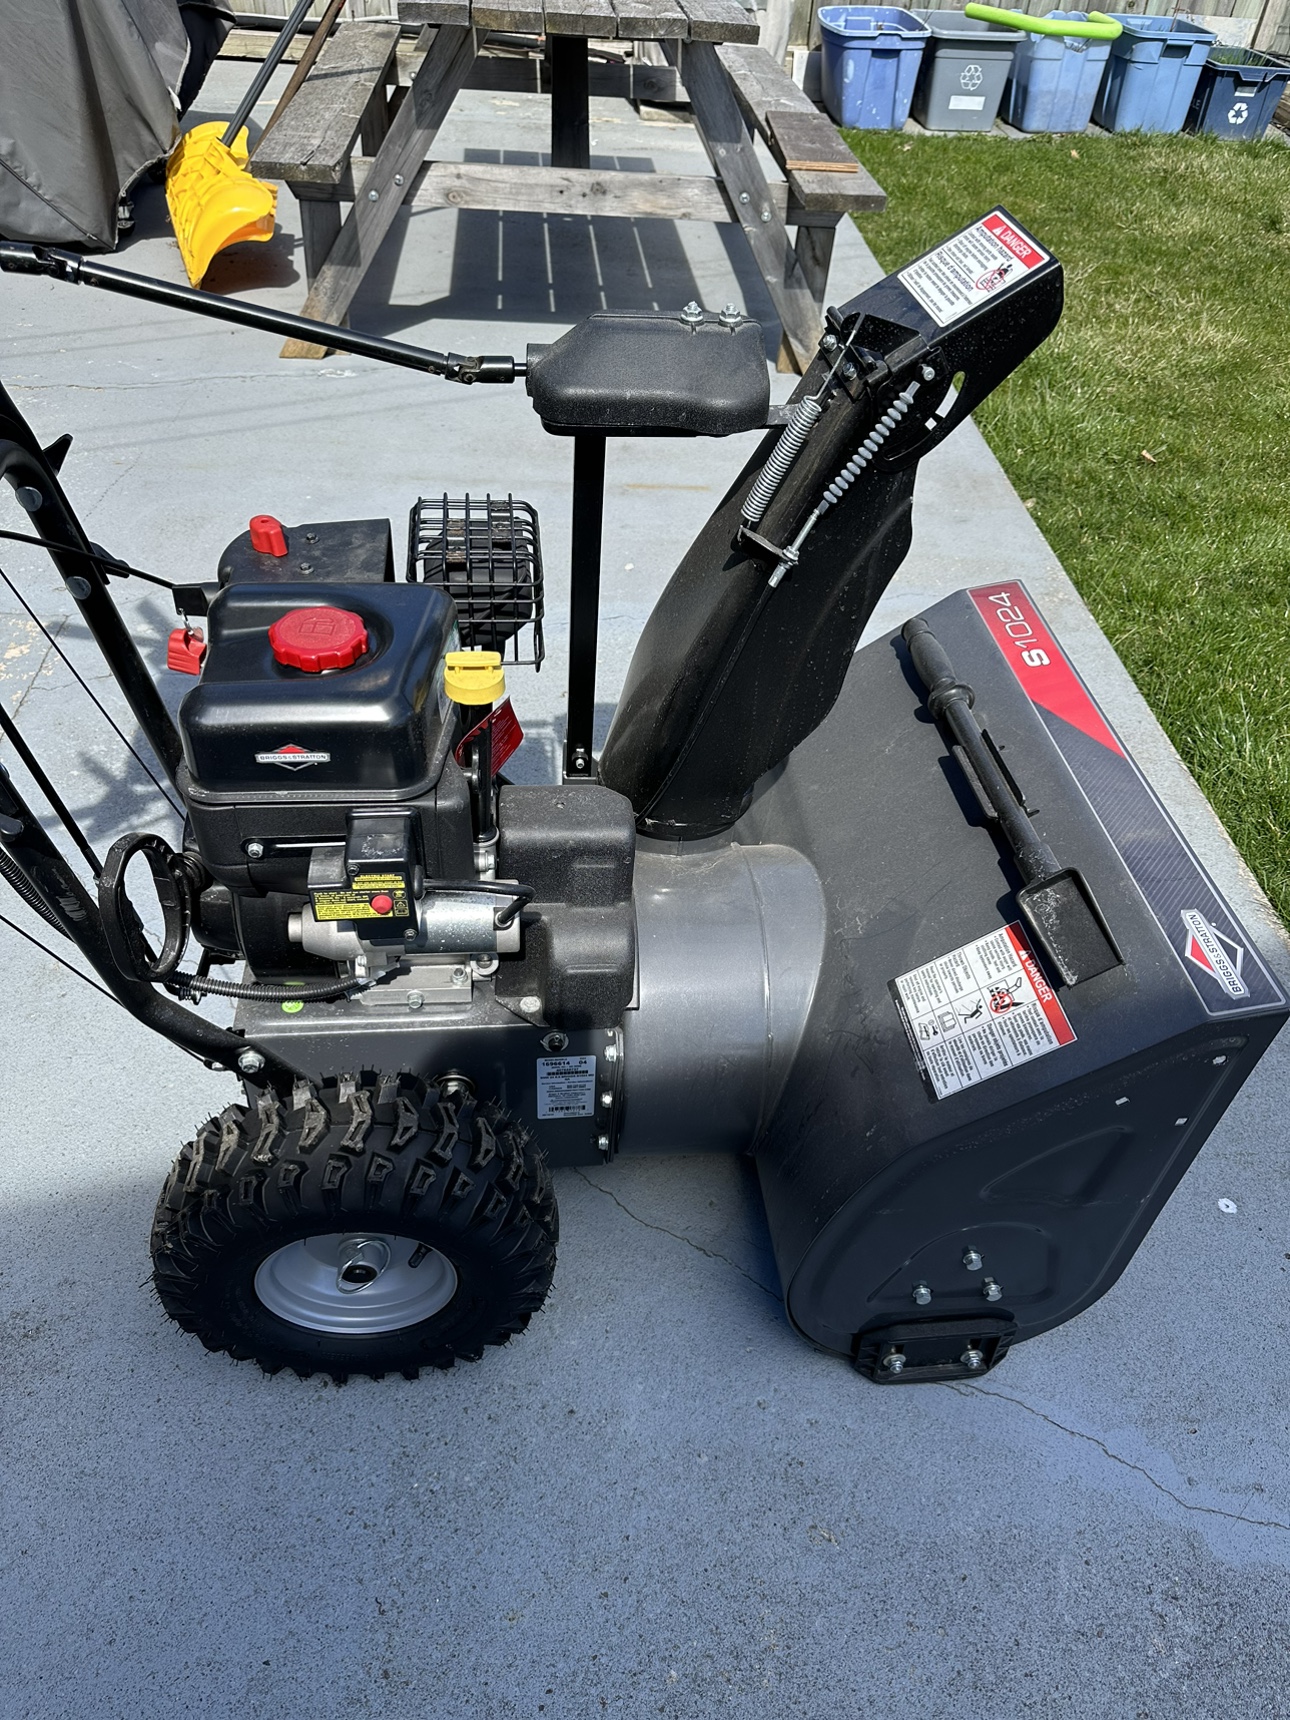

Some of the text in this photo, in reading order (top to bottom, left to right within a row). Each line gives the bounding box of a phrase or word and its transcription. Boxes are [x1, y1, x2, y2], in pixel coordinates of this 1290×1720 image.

[1000, 228, 1031, 258] DANGER
[988, 592, 1050, 668] S1024
[1024, 958, 1053, 1003] DANGER
